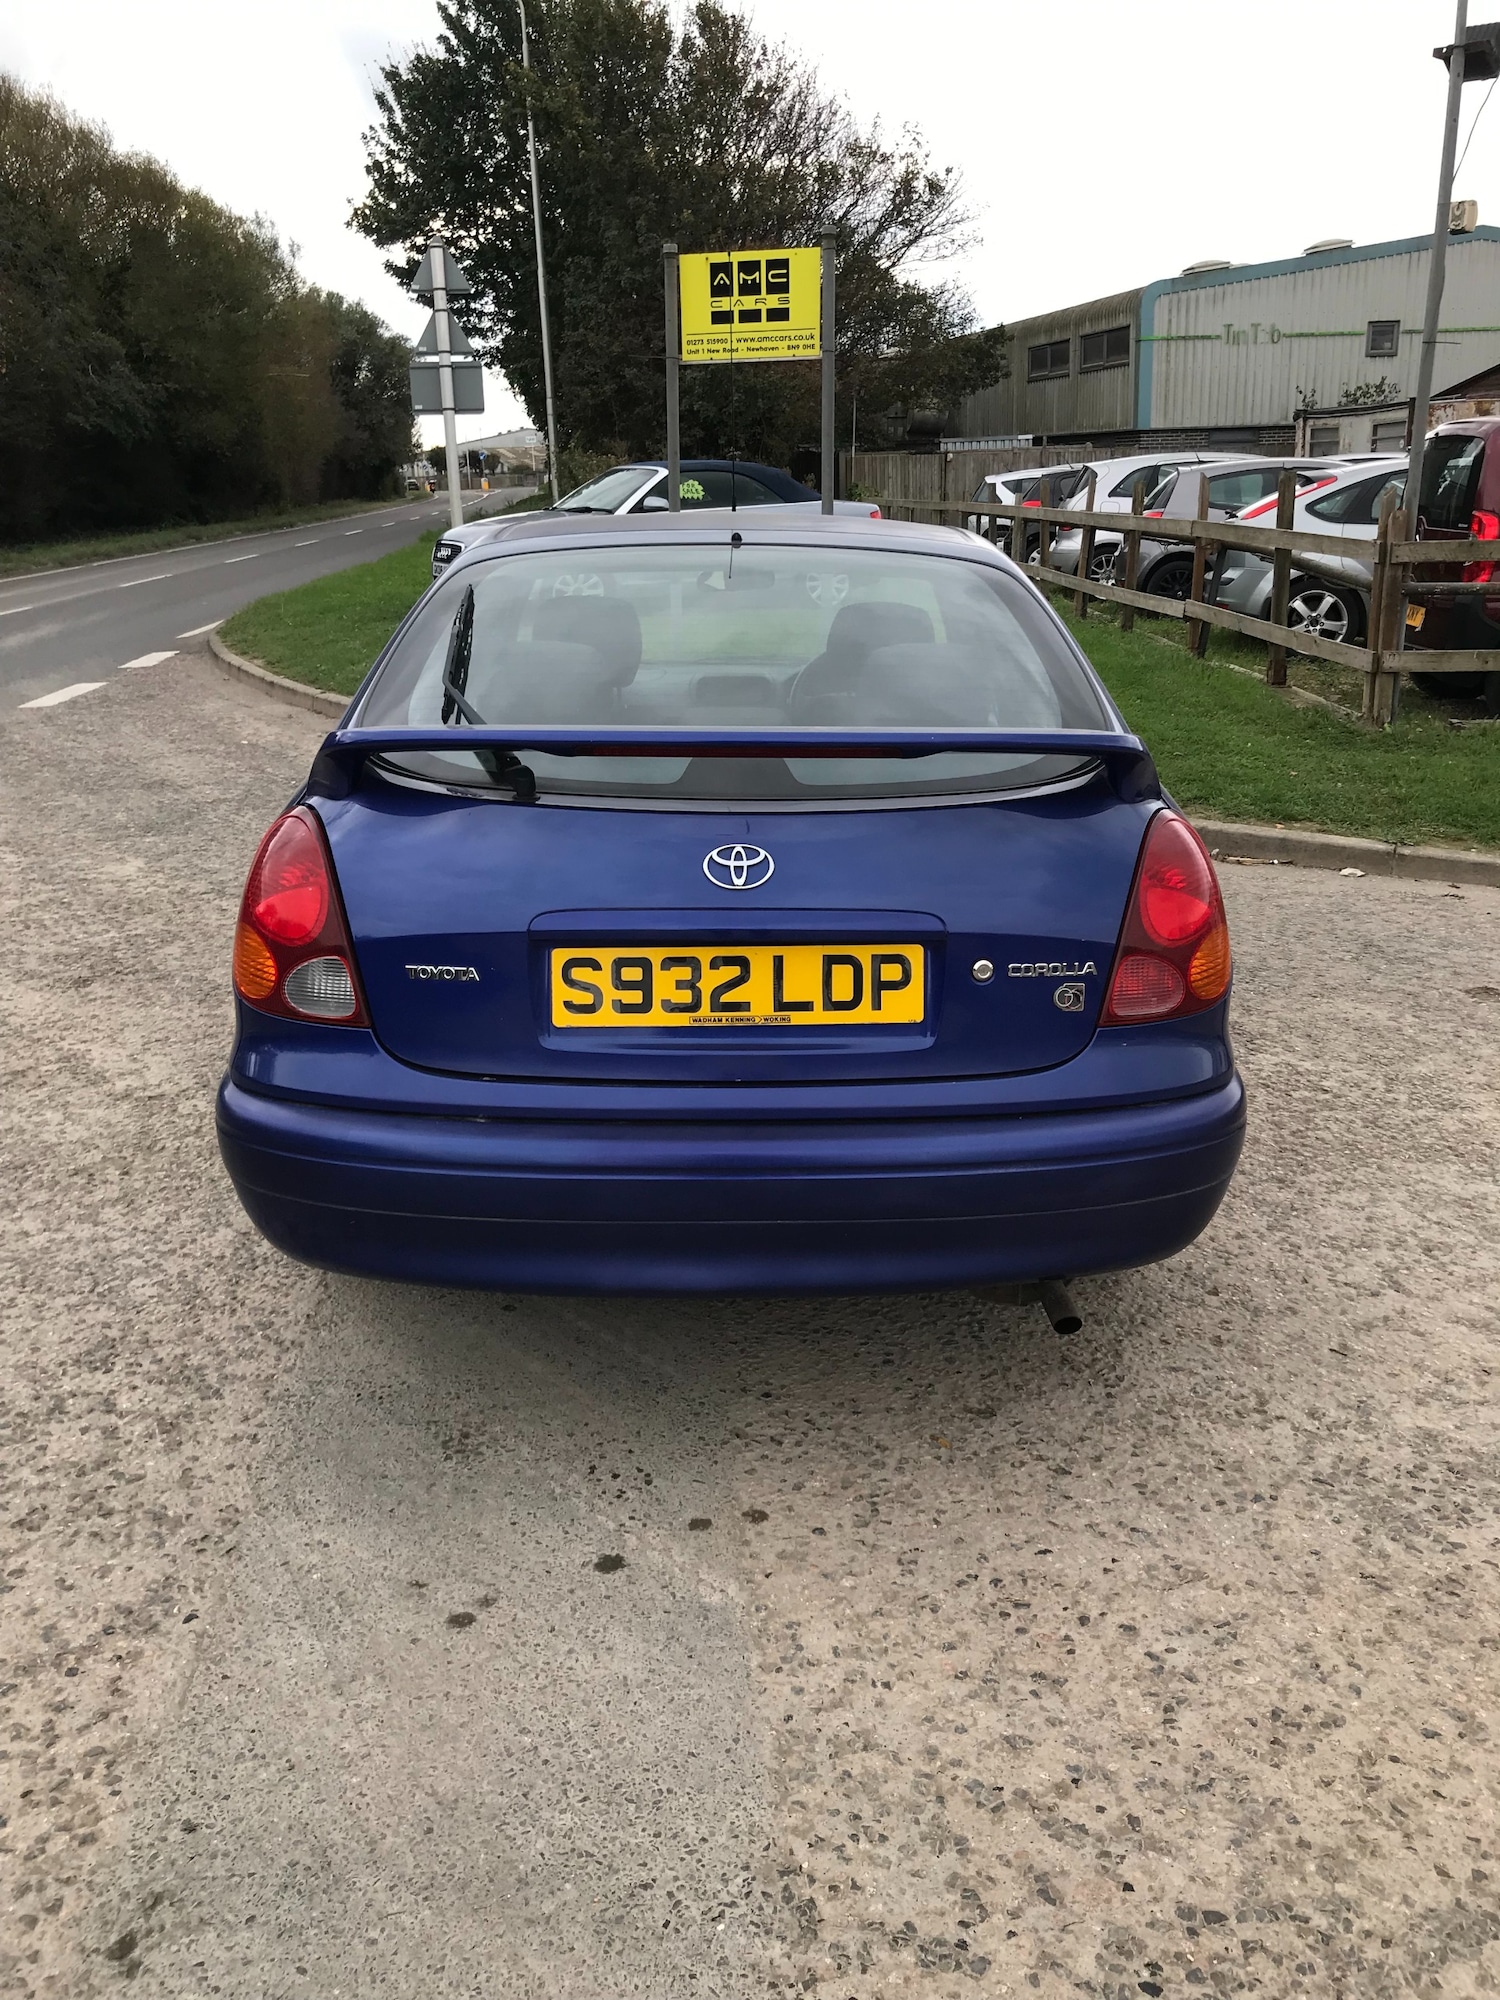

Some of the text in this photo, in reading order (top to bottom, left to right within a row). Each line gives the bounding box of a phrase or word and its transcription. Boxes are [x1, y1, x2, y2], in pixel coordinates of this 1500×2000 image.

[713, 269, 788, 286] AMC
[710, 296, 791, 309] CARS
[736, 333, 815, 344] www.amccars.co.uk
[405, 965, 480, 981] TOYOTA
[1008, 962, 1097, 977] COROLLA
[562, 953, 912, 1014] S932 LDP
[763, 1015, 791, 1023] WOKING
